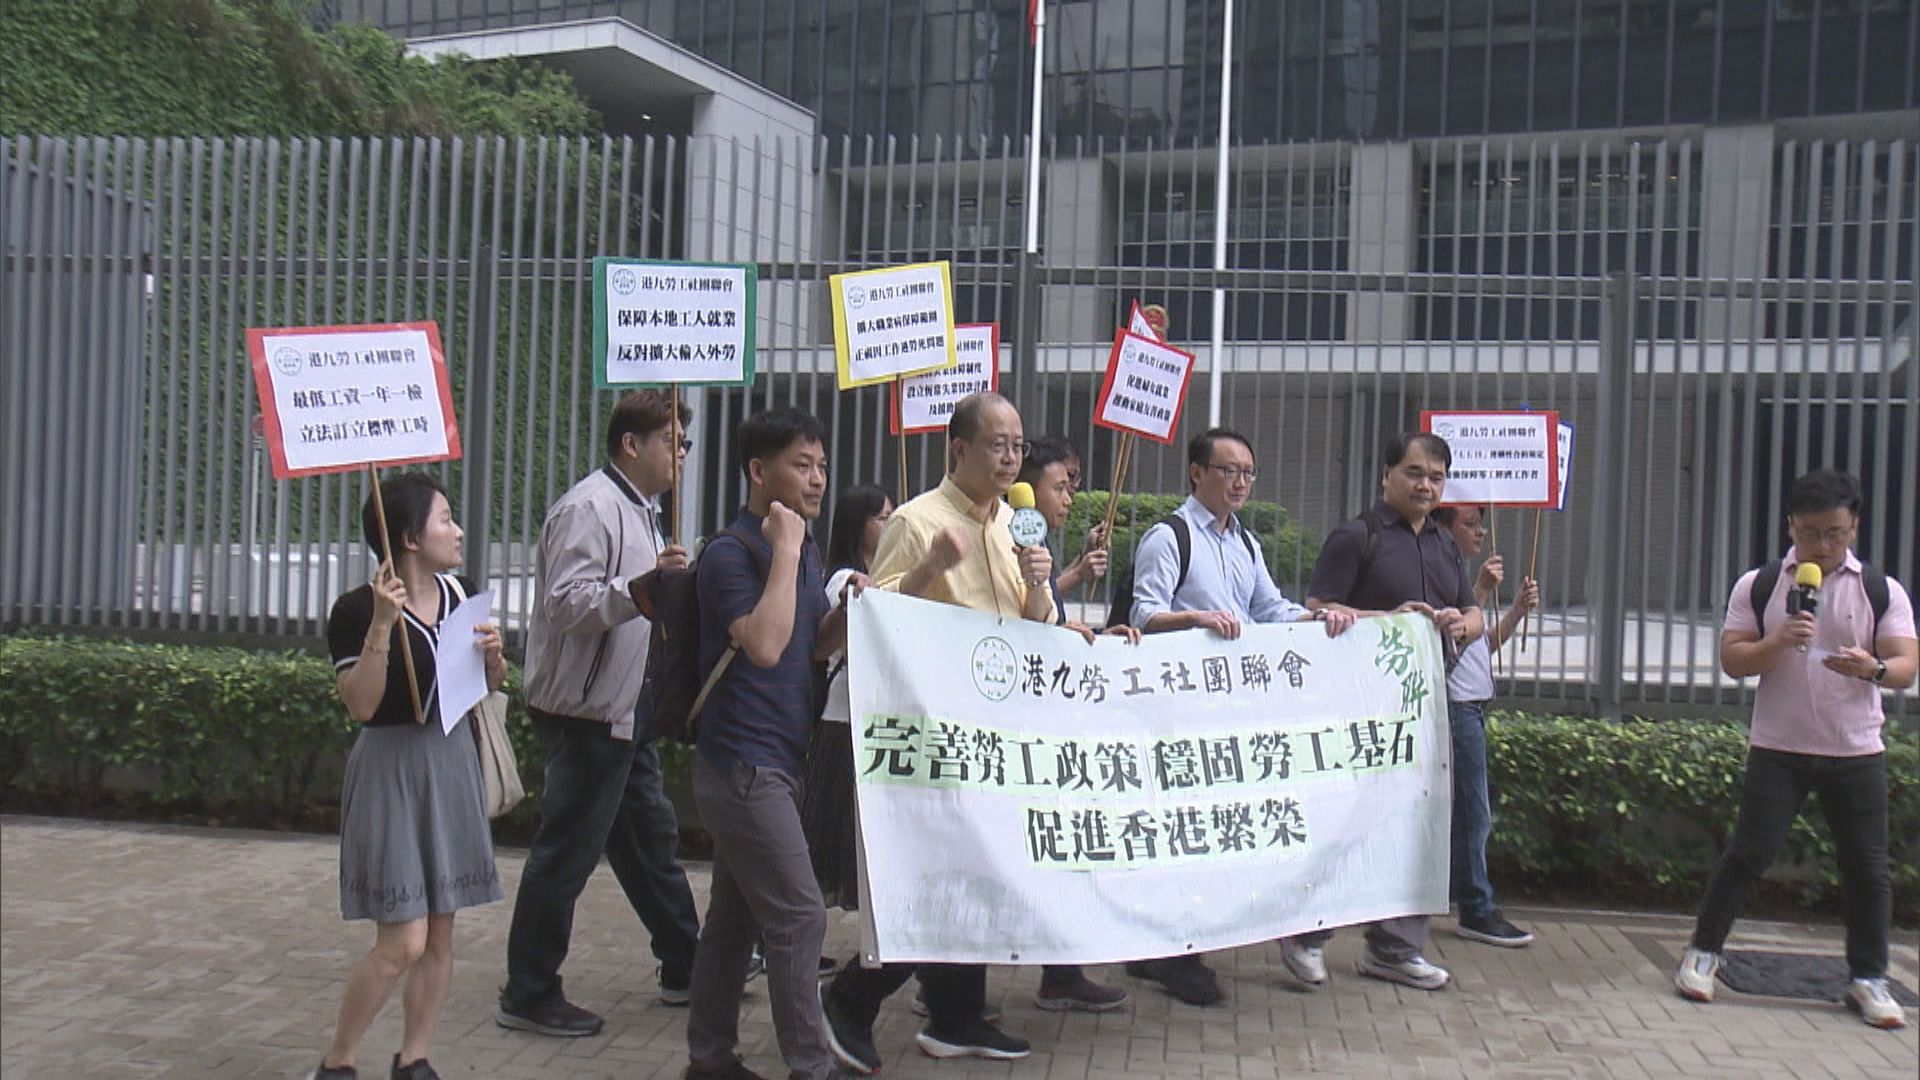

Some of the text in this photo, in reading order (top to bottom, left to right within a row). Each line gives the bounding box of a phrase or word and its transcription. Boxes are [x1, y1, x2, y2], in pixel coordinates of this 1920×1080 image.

[641, 276, 734, 293] 港九勞工社團聯會
[869, 281, 934, 301] 港九勞工社團聯會
[617, 309, 736, 328] 保障本地工人就業
[856, 310, 938, 335] 擴大職業病保障範圍
[308, 348, 416, 369] 港九勞工社團聯會
[616, 343, 736, 362] 反對擴大輸入外勞
[855, 335, 944, 362] 正視因工作過勞死問題
[293, 383, 423, 410] 最低工資一年一檢
[300, 416, 428, 444] 立法訂立標準工時
[1021, 650, 1311, 703] 港九勞工社團聯會
[863, 715, 1416, 792] 完善勞工政策 穩固勞工基石
[1026, 796, 1307, 864] 促進香港繁榮
